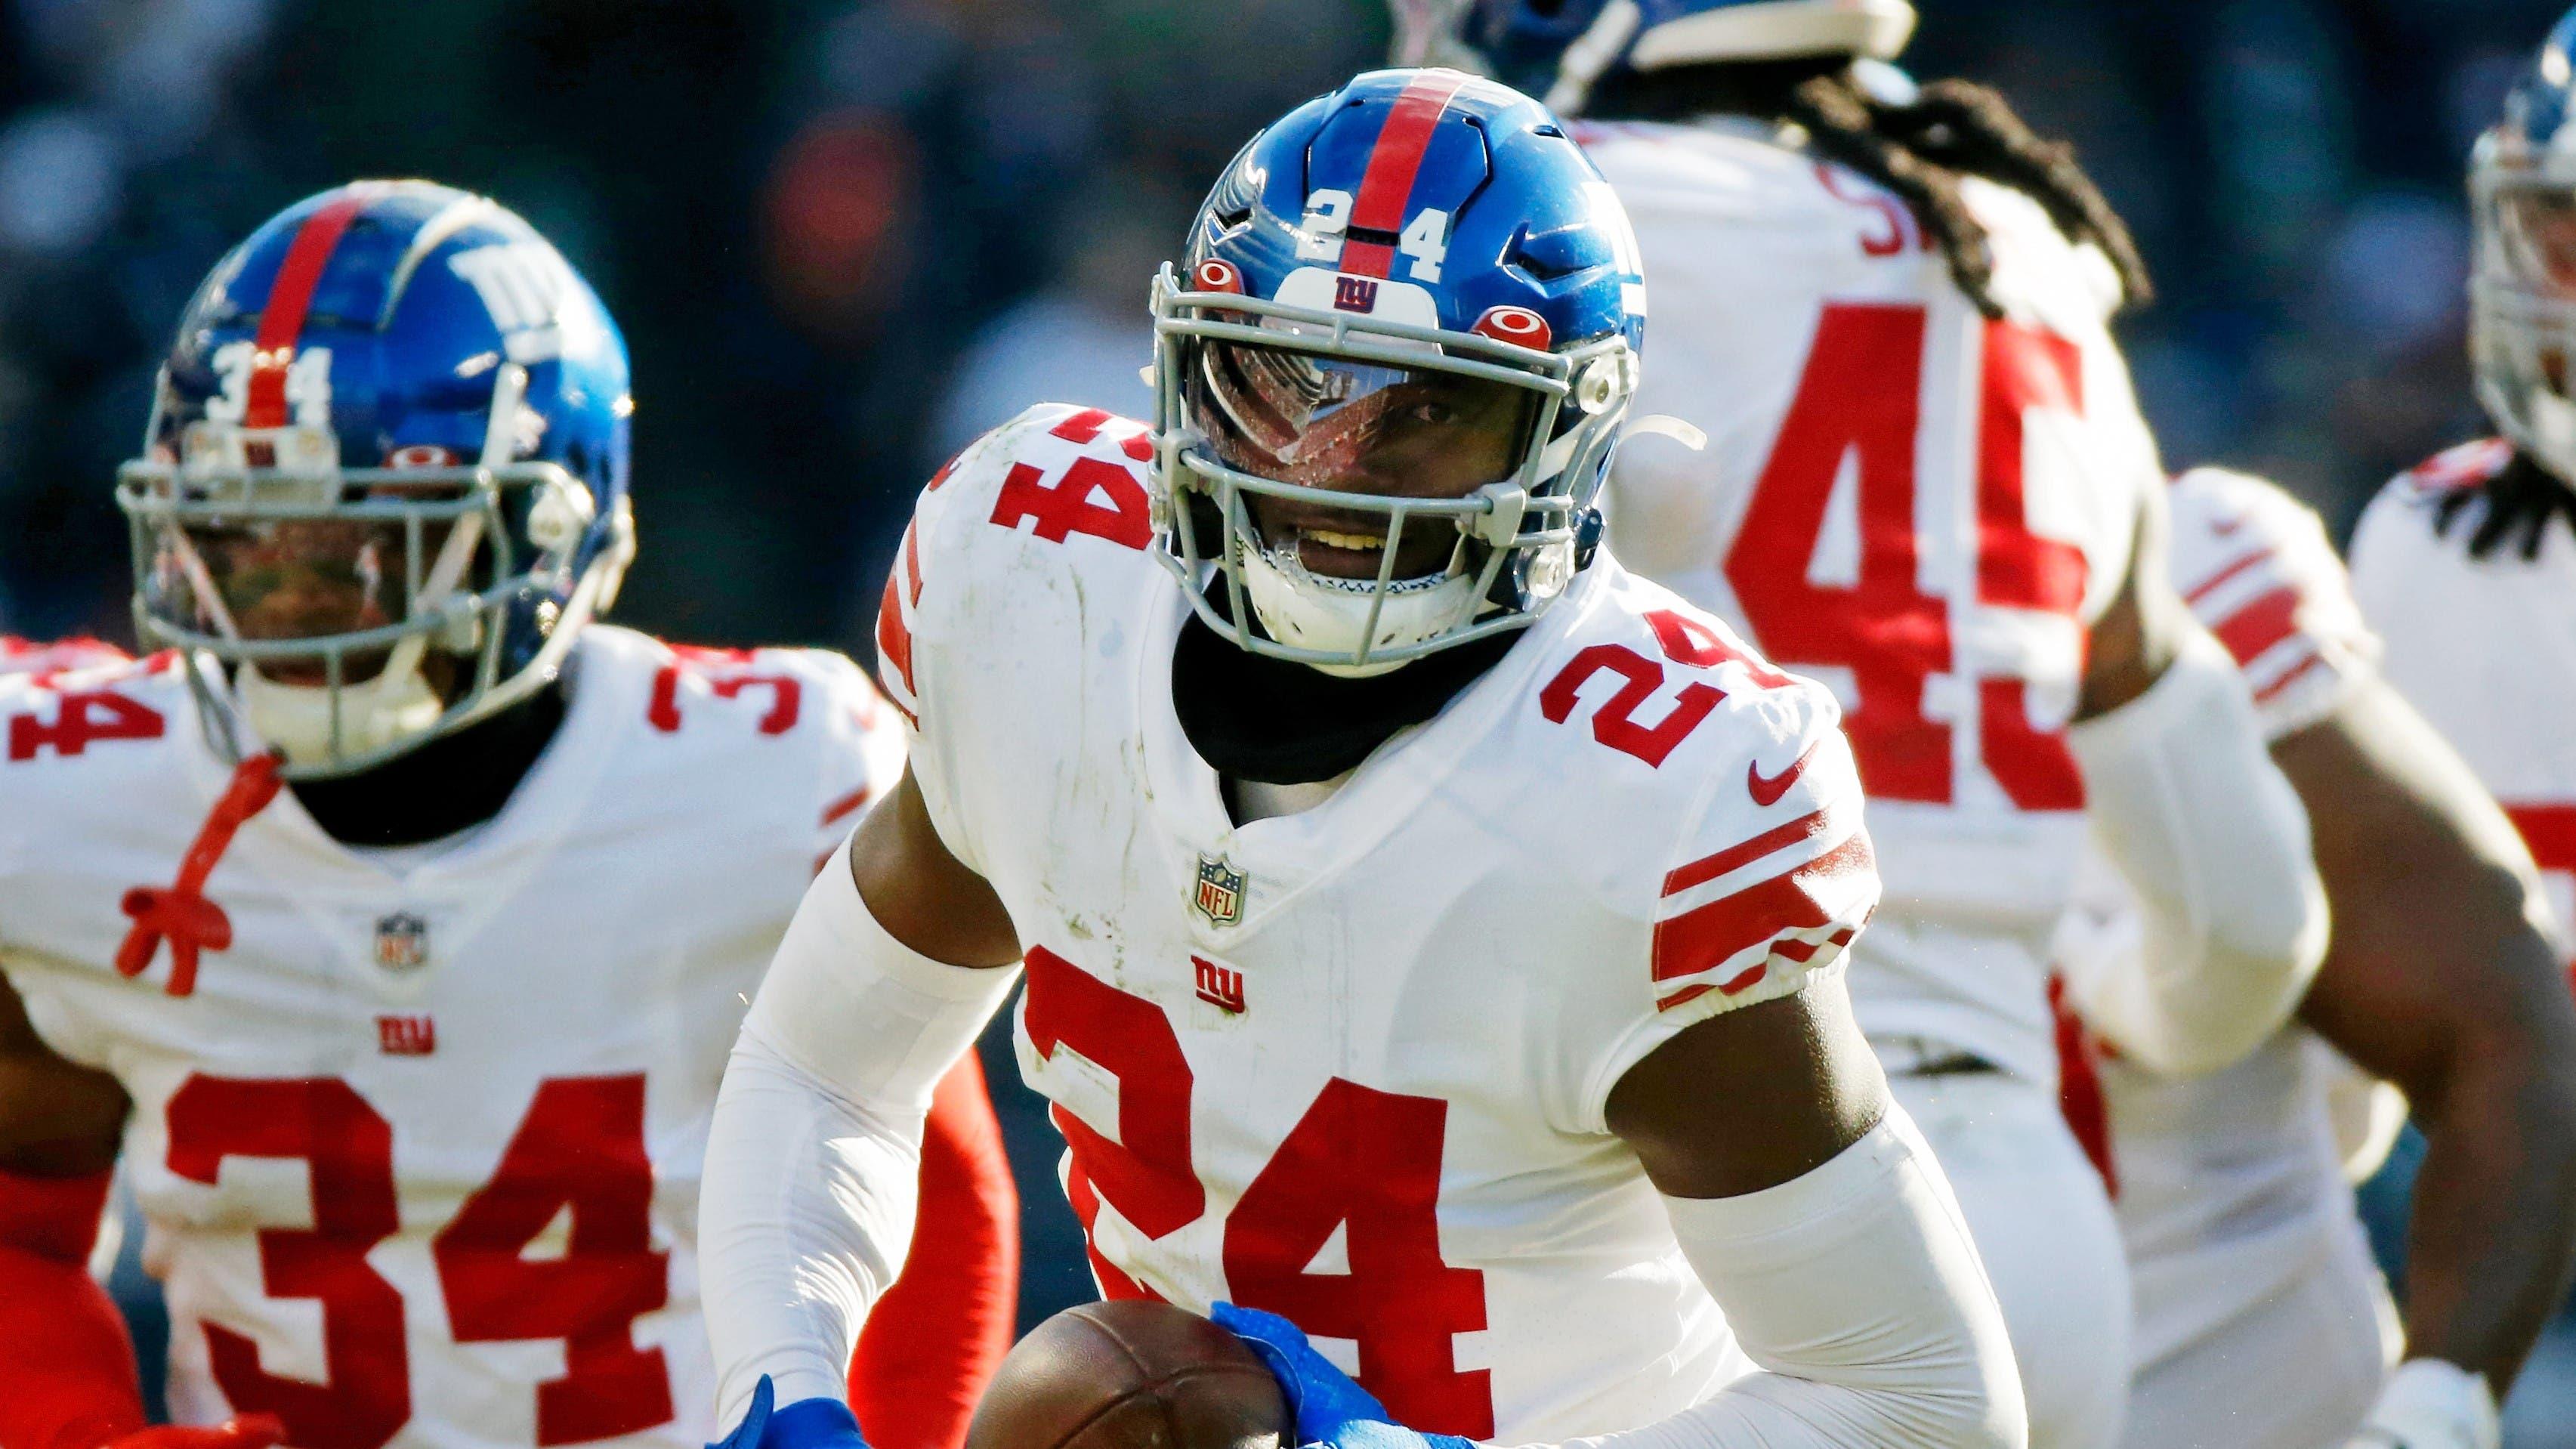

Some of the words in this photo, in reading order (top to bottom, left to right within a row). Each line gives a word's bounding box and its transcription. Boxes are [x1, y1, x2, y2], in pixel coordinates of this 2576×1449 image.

[1295, 188, 1446, 285] 24
[205, 341, 333, 428] 34
[1720, 299, 2090, 813] 45
[1199, 881, 1233, 916] NFL
[164, 1071, 675, 1449] 34
[1022, 944, 1495, 1440] 24
